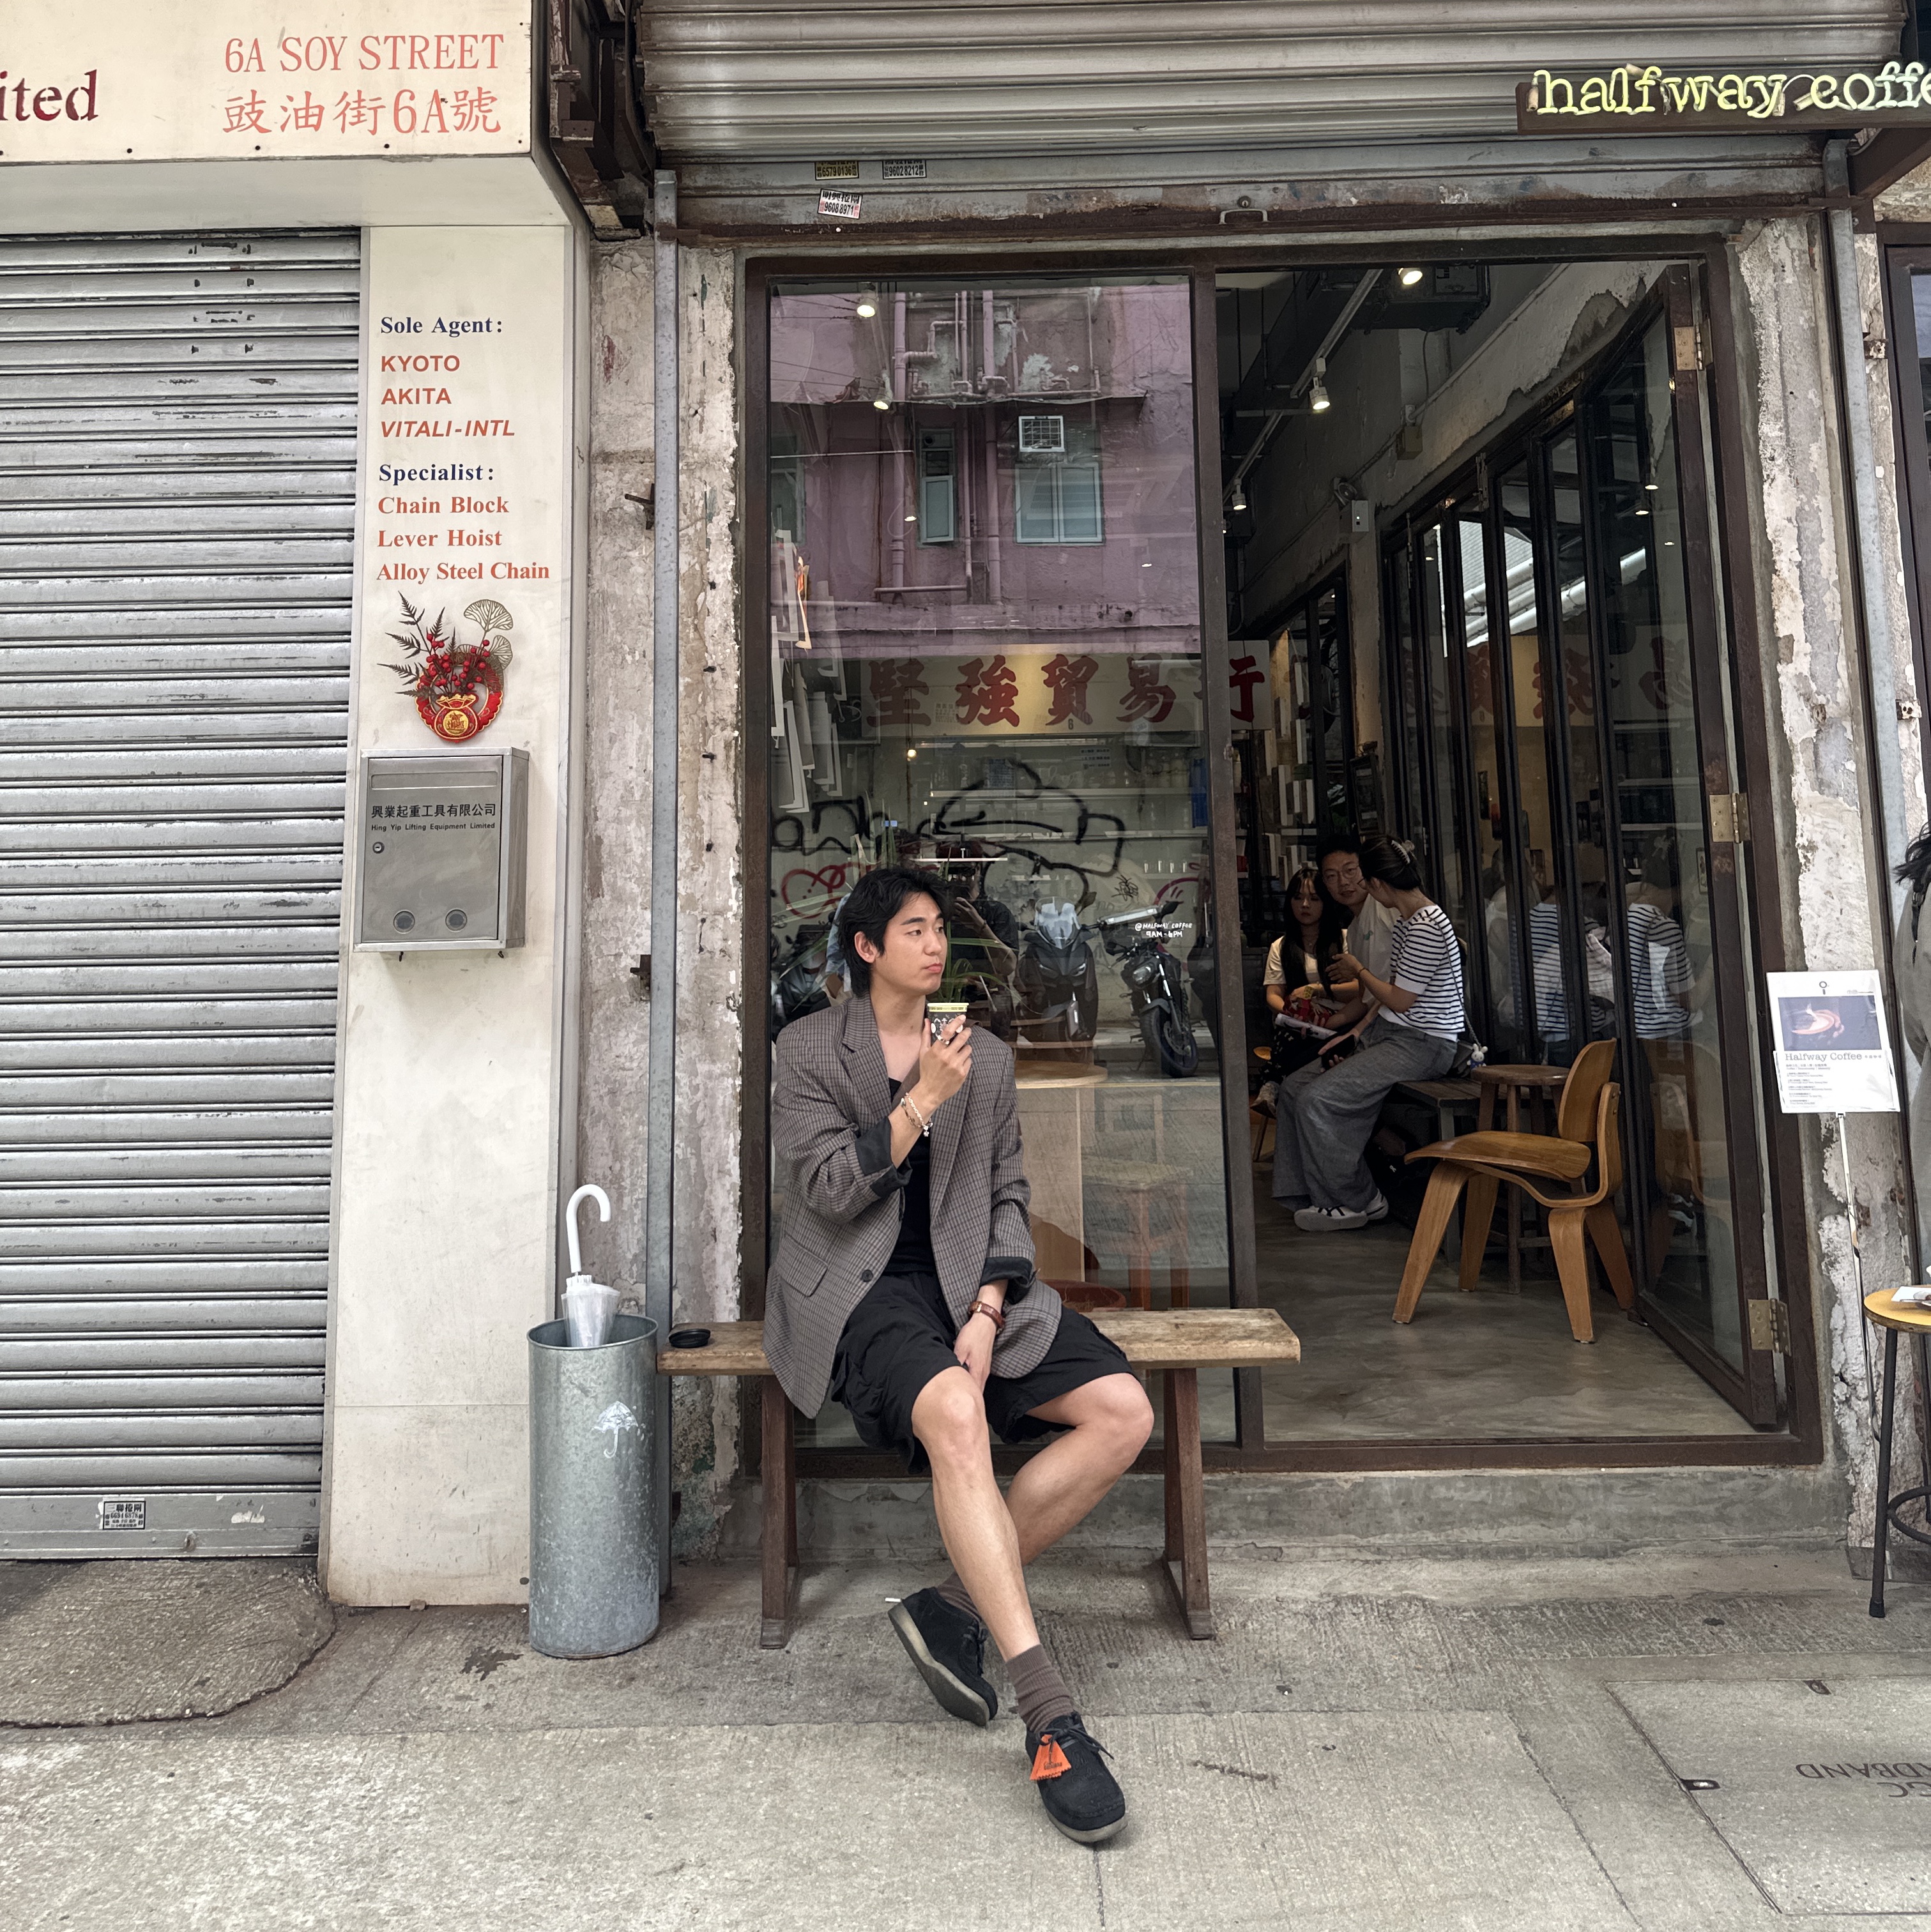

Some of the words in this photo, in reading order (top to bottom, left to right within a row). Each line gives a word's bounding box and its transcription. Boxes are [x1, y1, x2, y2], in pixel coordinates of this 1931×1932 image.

[224, 38, 266, 73] 6A
[280, 36, 348, 72] SOY
[358, 34, 504, 71] STREET
[1533, 66, 1787, 118] halfway
[222, 86, 501, 135] 豉油街6A號
[381, 317, 423, 334] Sole
[381, 354, 460, 372] KYOTO
[381, 388, 452, 405] AKITA
[381, 420, 515, 437] VITALI-INTL
[379, 464, 494, 486] Specialist:
[378, 497, 440, 514] Chain
[450, 496, 510, 513] Block
[378, 530, 438, 547] Lever
[448, 529, 503, 547] Hoist
[377, 563, 430, 584] Alloy
[437, 563, 483, 580] Steel
[491, 562, 550, 579] Chain
[371, 803, 496, 818] 興業起重工具有限公司
[1785, 1053, 1828, 1062] Halfway
